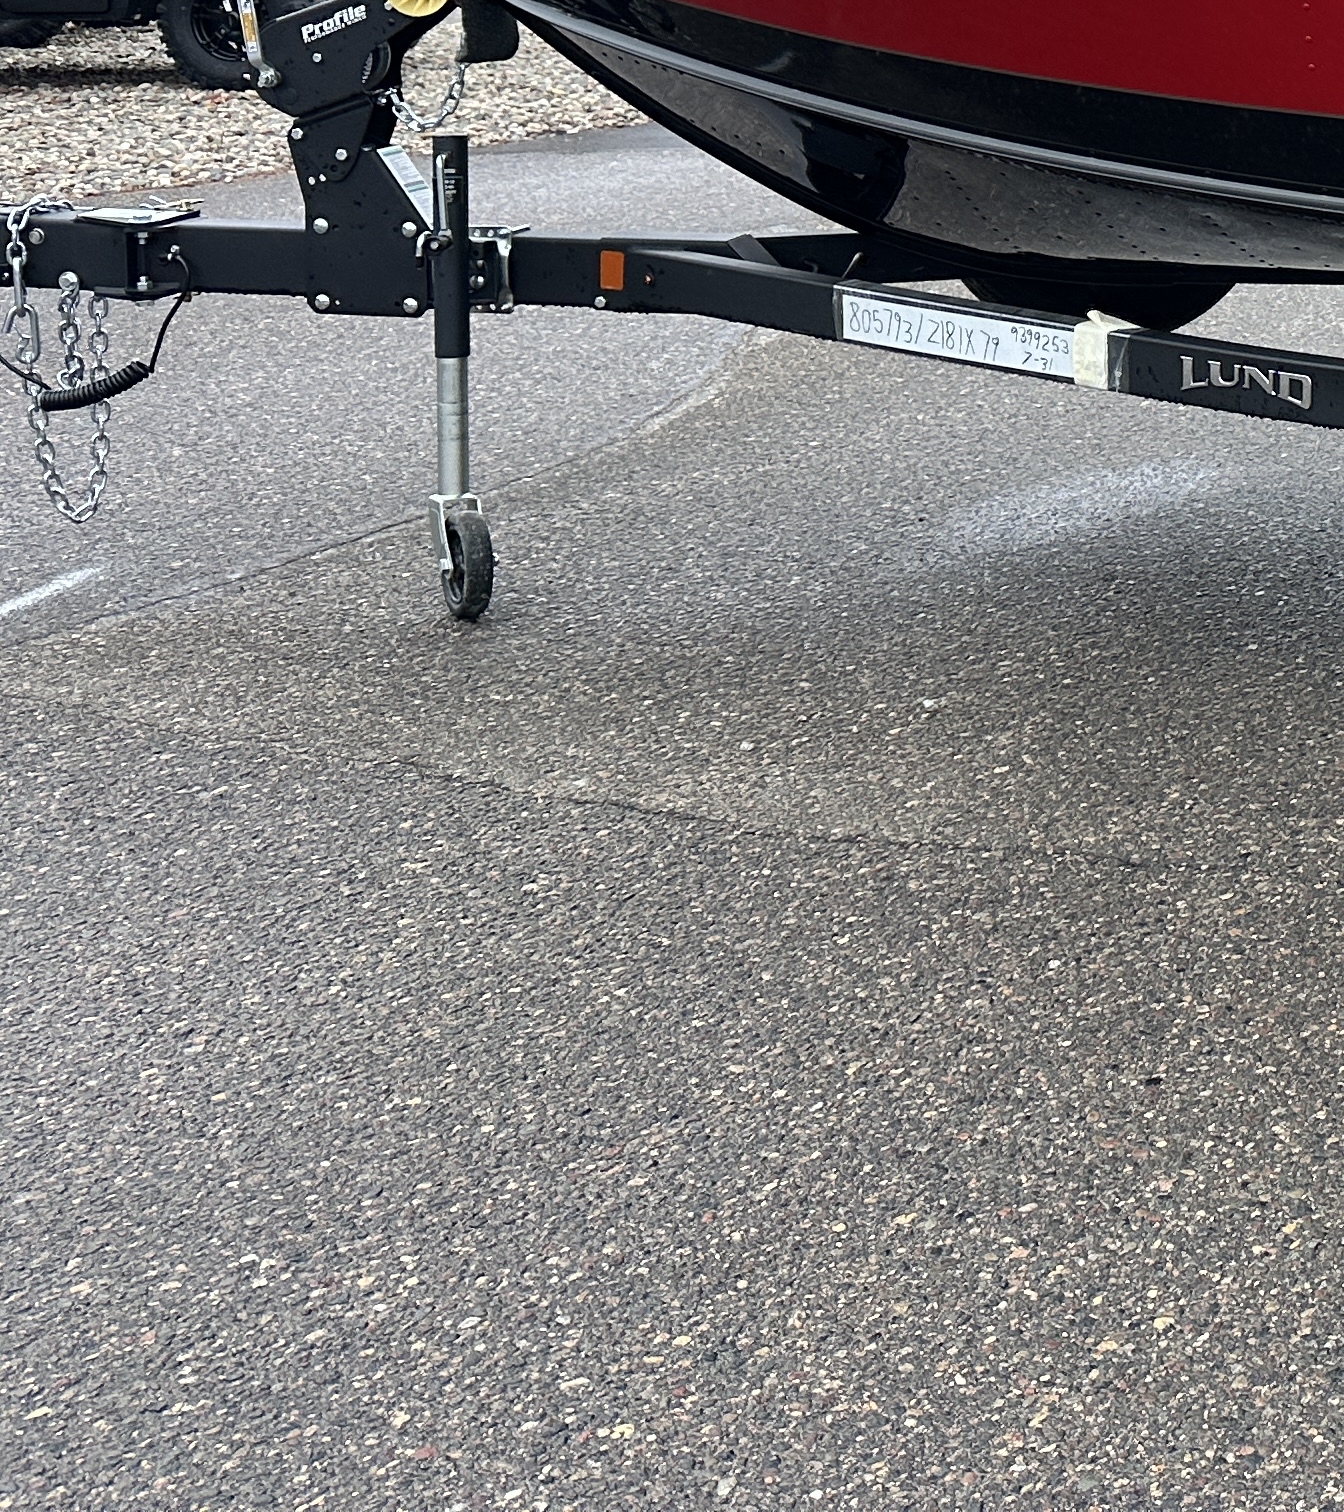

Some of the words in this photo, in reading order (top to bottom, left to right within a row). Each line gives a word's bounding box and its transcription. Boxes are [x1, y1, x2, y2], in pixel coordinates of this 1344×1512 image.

[301, 4, 367, 39] Profile
[1010, 326, 1070, 355] 9399253
[1022, 350, 1054, 371] 7-31
[1179, 355, 1313, 411] LUND
